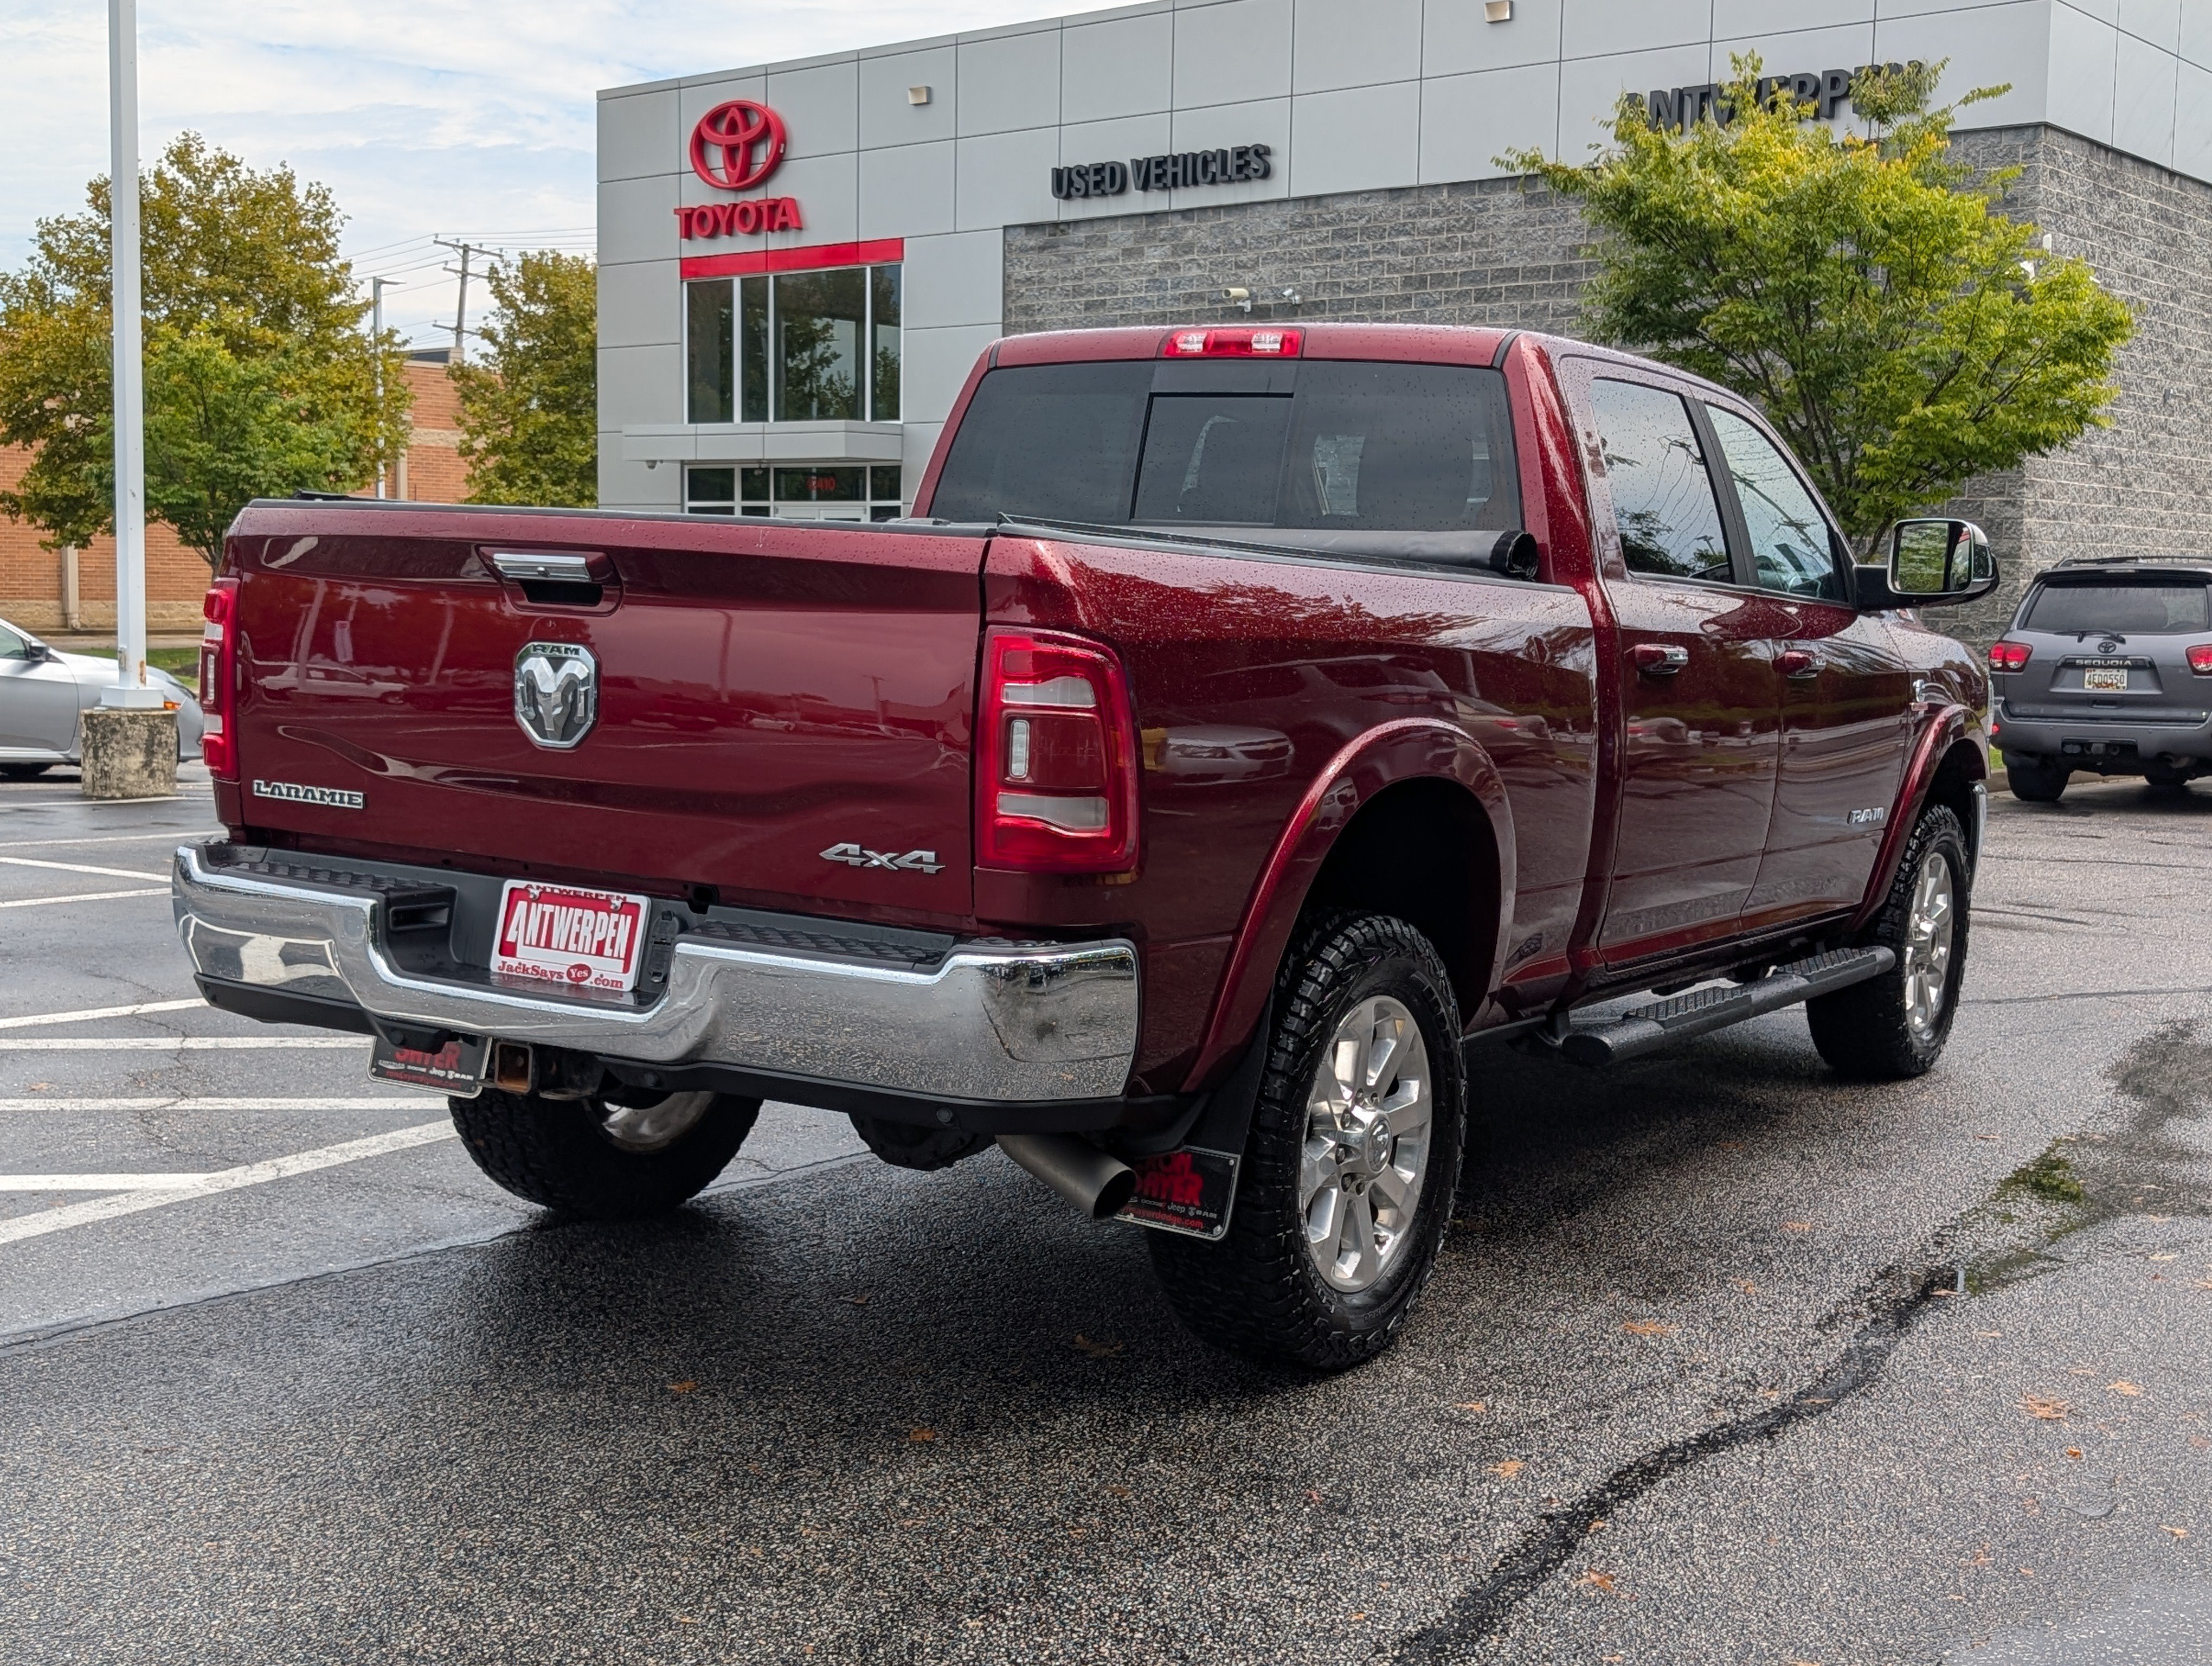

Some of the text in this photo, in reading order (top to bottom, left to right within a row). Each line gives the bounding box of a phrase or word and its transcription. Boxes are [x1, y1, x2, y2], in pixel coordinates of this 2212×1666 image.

[1051, 144, 1271, 200] USED VEHICLES
[673, 196, 803, 240] TOYOTA
[531, 643, 580, 656] RAM
[253, 779, 364, 809] LARAMIE
[1847, 806, 1884, 824] RAM
[818, 842, 946, 874] 4x4
[524, 884, 627, 902] ANTWERPEN
[505, 900, 633, 959] ANTWERPEN
[1167, 1201, 1186, 1214] Jeep
